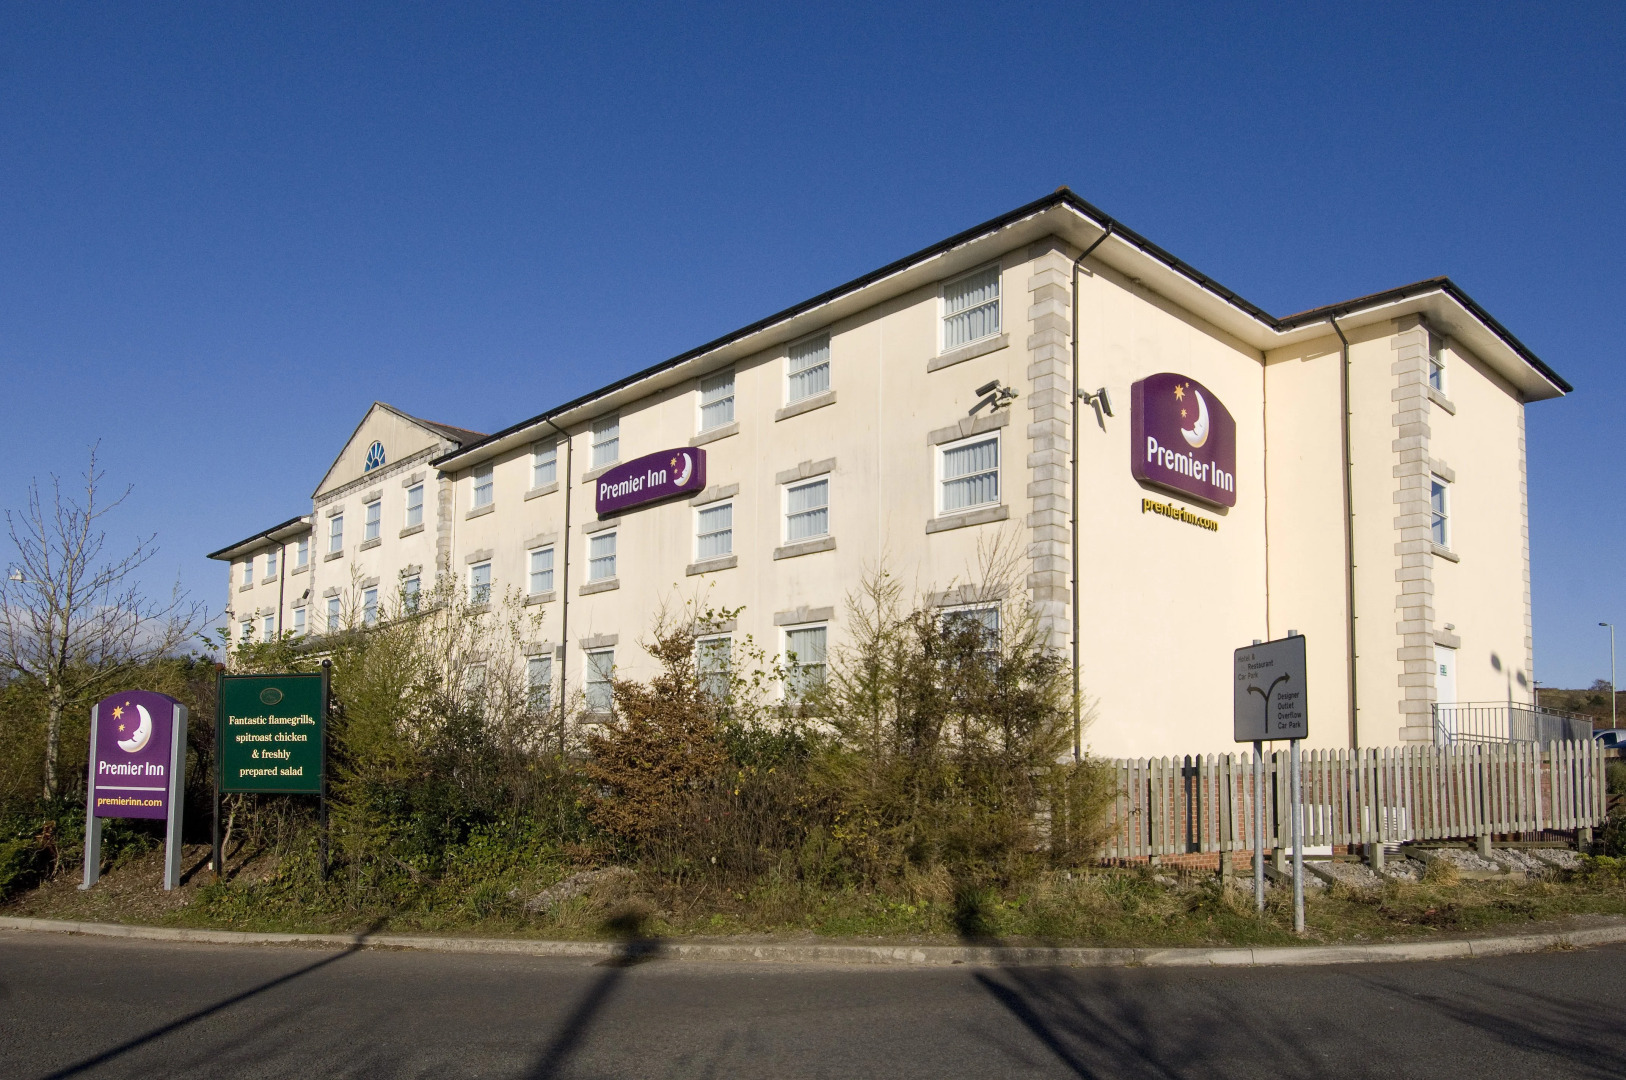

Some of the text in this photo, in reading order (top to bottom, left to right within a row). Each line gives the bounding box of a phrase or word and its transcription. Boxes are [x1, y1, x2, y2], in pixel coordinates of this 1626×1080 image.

[1147, 436, 1233, 492] Premier Inn
[600, 470, 666, 501] Premier Inn
[1142, 498, 1218, 532] premierinn.com
[1248, 660, 1274, 670] Restaurant
[1278, 692, 1300, 700] Designer
[228, 714, 316, 726] Fantastic flamegrills,
[1278, 712, 1302, 720] Overflow
[236, 732, 308, 744] spitroast chicken
[252, 749, 291, 760] & freshly
[98, 760, 164, 776] Premier Inn
[240, 766, 303, 778] prepared salad
[97, 796, 162, 807] premierinn.com
